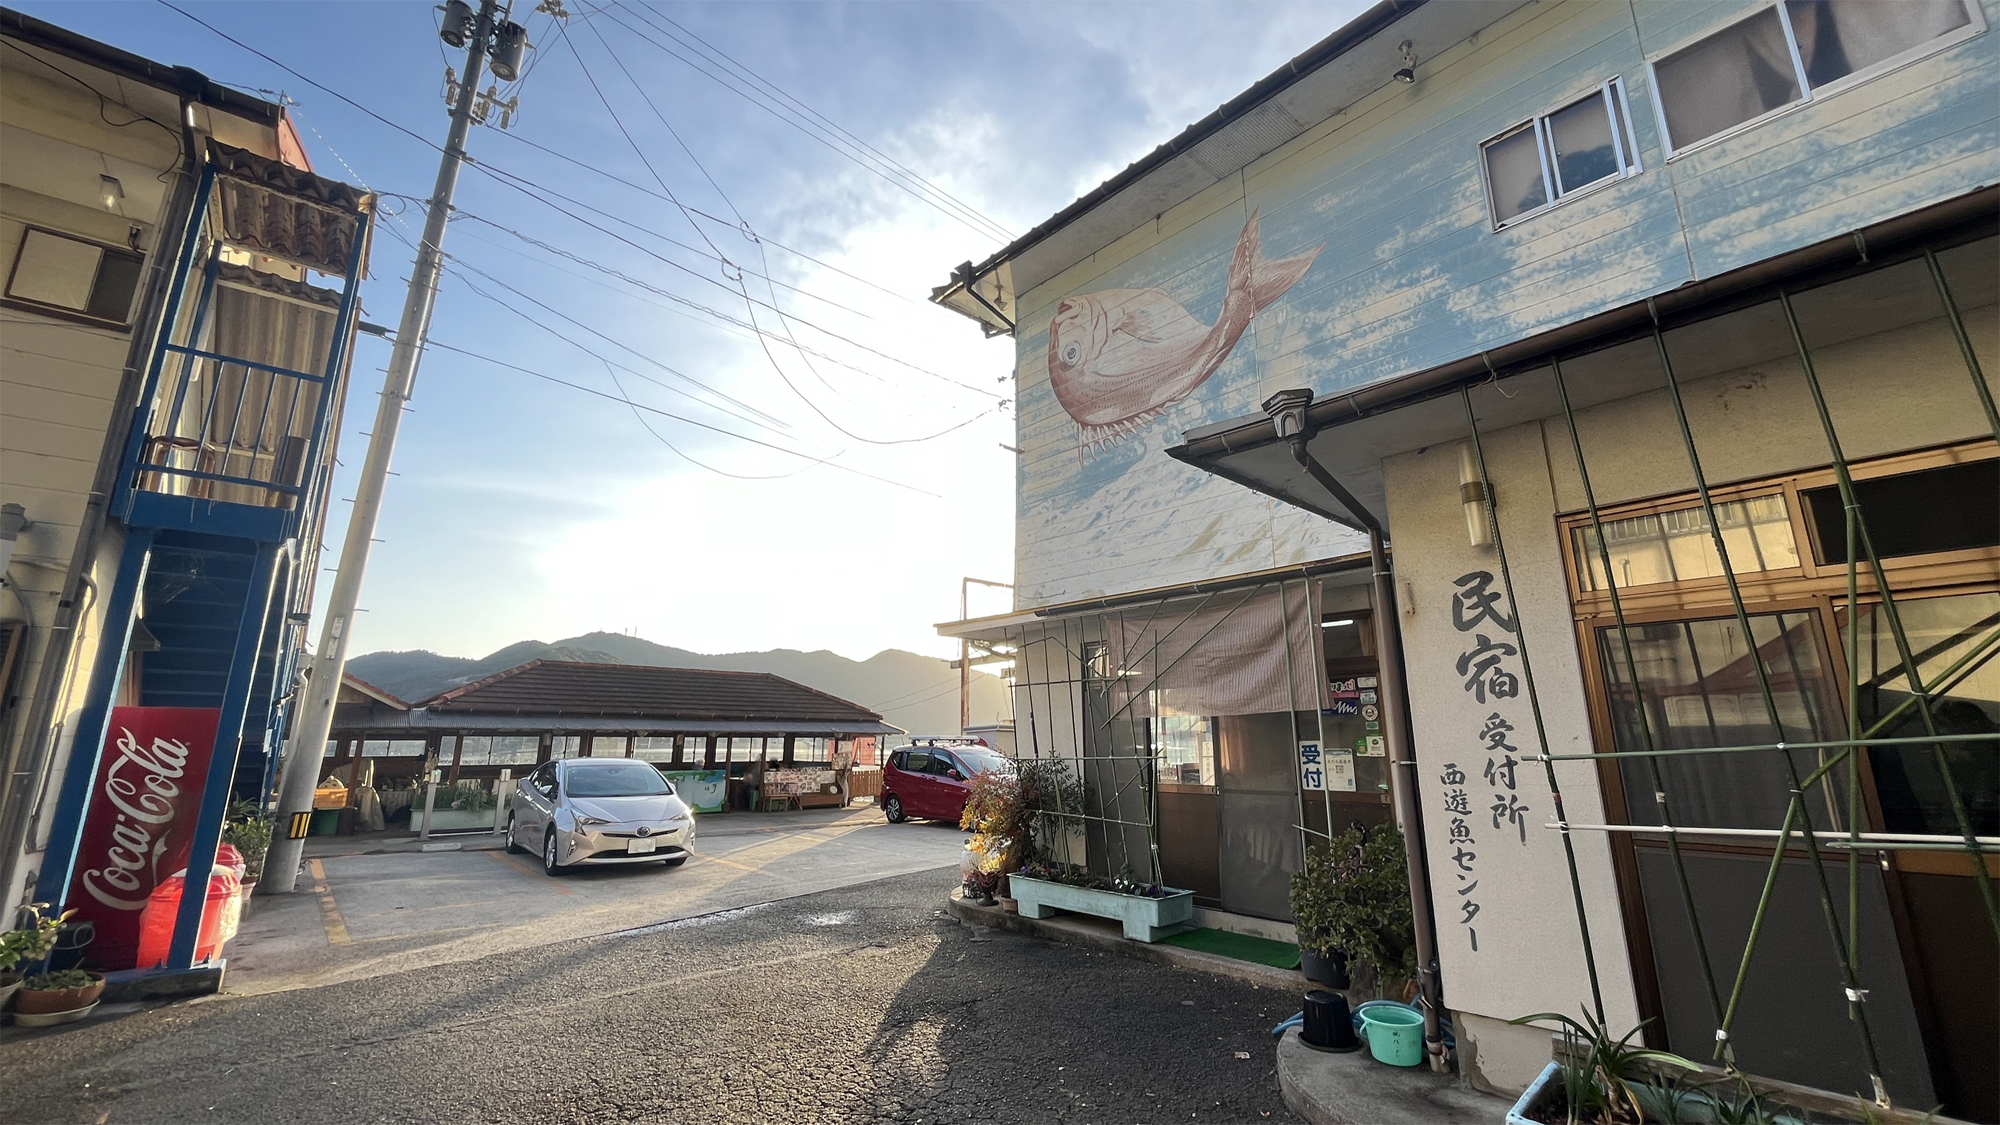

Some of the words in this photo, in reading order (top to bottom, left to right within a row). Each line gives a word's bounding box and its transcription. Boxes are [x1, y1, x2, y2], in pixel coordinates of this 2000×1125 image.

[83, 726, 190, 911] Coca-Cola
[1301, 744, 1323, 789] 受付
[1440, 763, 1481, 952] 西遊魚センター
